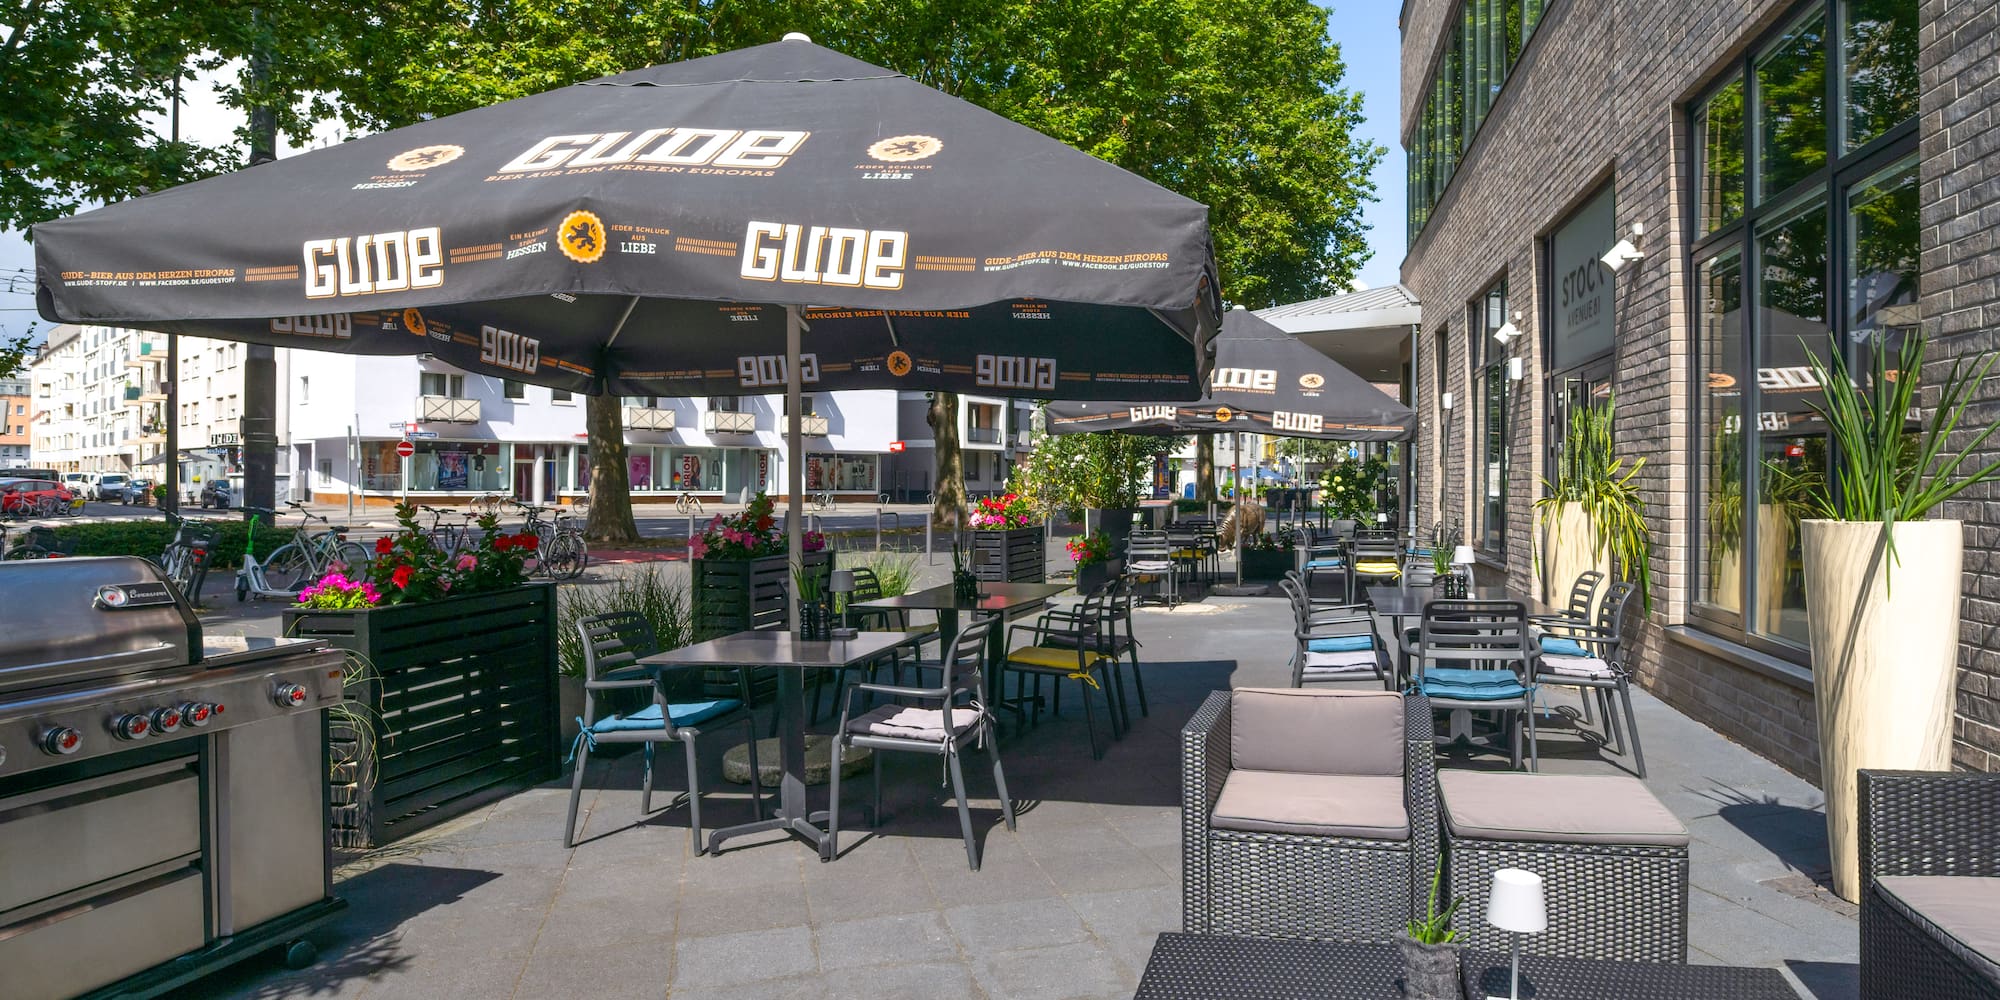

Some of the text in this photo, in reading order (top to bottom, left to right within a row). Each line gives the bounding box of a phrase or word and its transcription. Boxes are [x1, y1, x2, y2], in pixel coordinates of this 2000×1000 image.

[483, 164, 776, 183] BIER AUS DEM HERZEN EUROPAS
[352, 181, 418, 190] HESSEN
[611, 224, 671, 235] JEDER SCHLUCK
[631, 234, 646, 242] AUS
[506, 241, 548, 260] HESSEN
[621, 242, 657, 254] LIEBE
[1037, 250, 1058, 258] AUS
[1059, 252, 1082, 261] DEM
[1083, 253, 1122, 263] HERZEN
[1123, 253, 1169, 262] EUROPAS
[114, 271, 135, 280] AUS
[136, 271, 157, 279] DEM
[158, 270, 193, 279] HERZEN
[194, 269, 236, 277] EUROPAS
[1568, 300, 1593, 328] AVENUE
